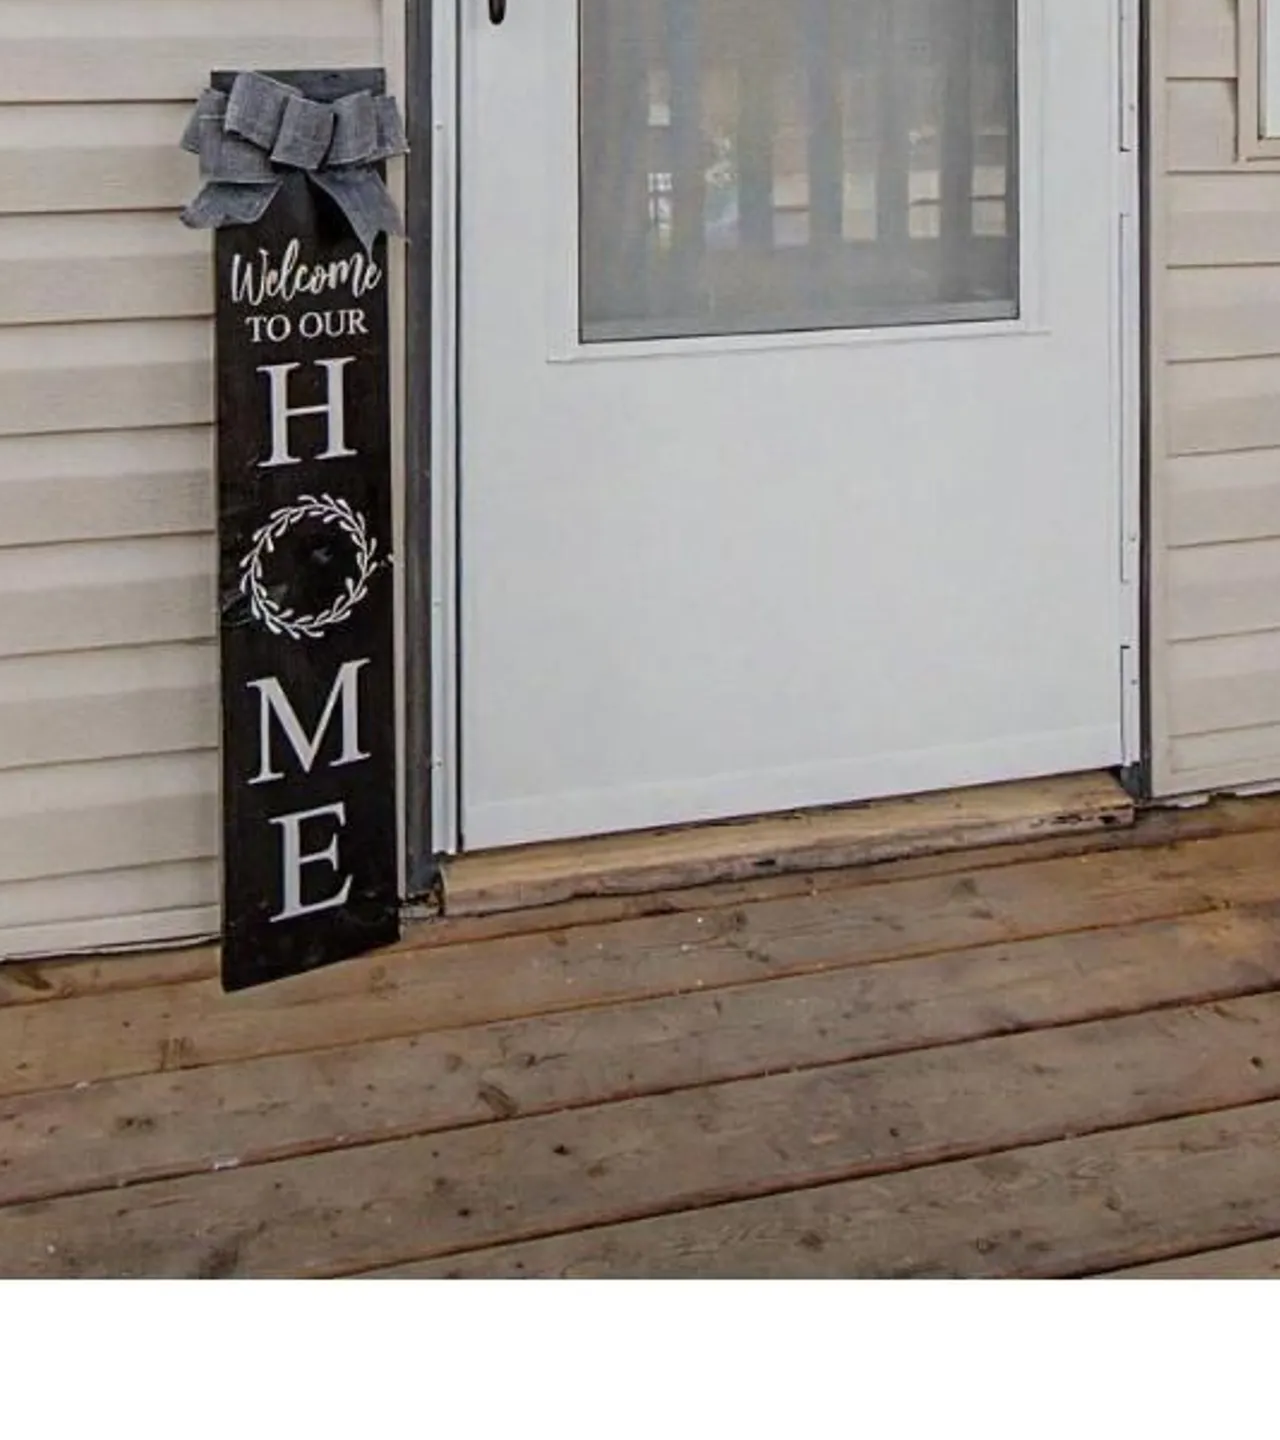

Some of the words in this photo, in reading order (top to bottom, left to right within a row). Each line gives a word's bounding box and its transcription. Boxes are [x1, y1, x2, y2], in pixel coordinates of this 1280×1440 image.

[231, 238, 382, 306] Welcome
[244, 314, 291, 342] TO
[299, 308, 369, 338] OUR
